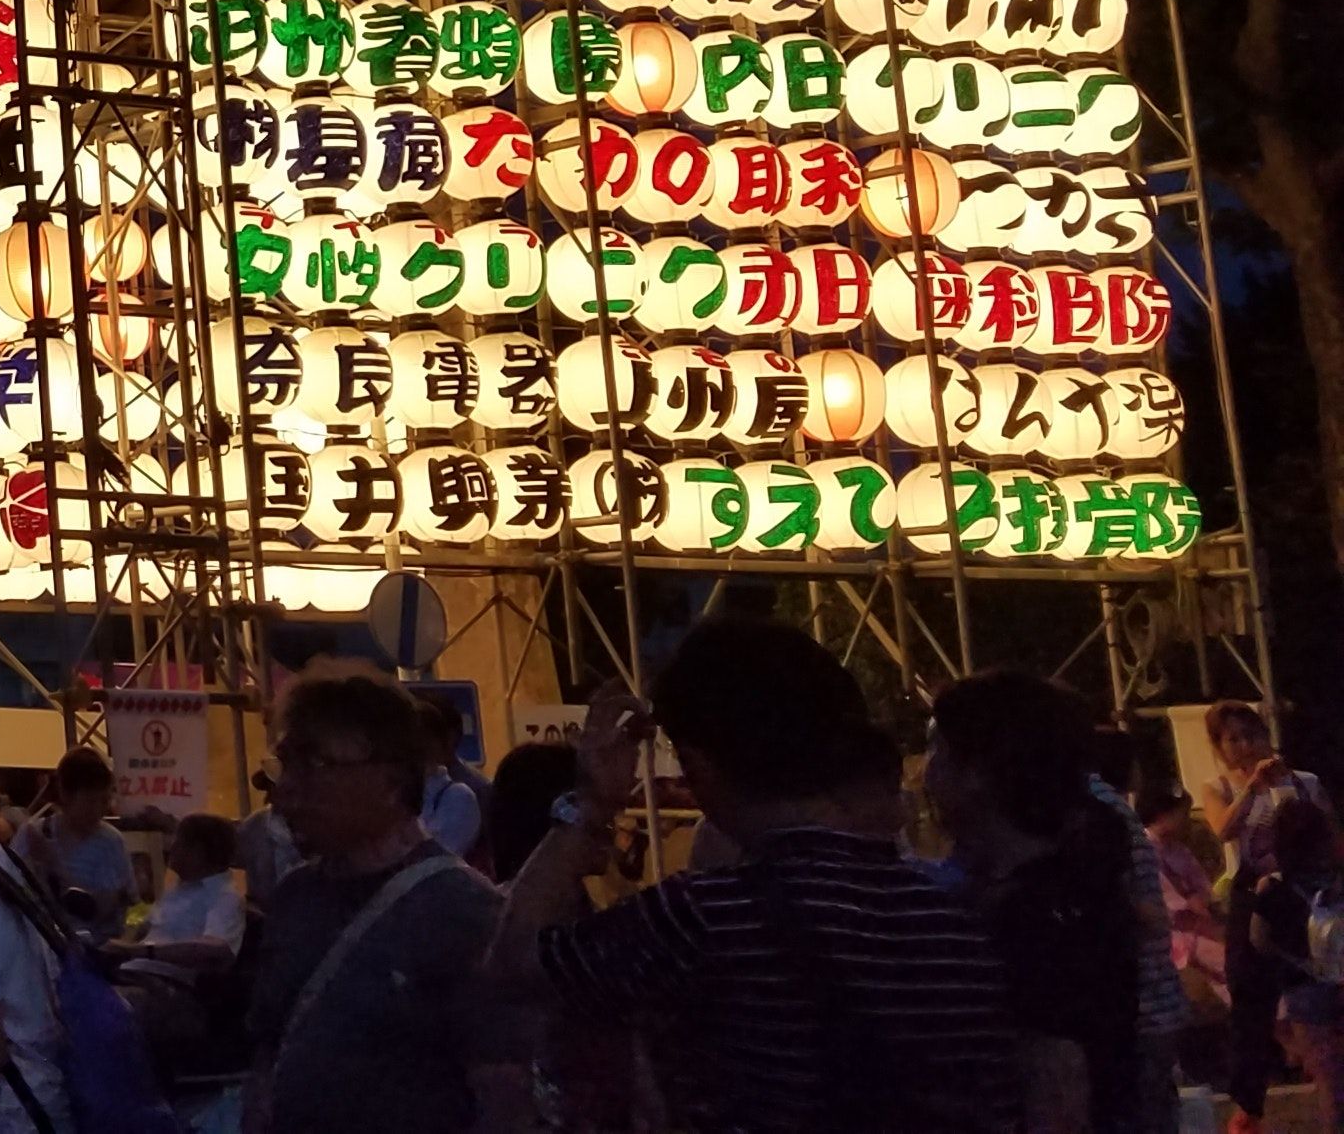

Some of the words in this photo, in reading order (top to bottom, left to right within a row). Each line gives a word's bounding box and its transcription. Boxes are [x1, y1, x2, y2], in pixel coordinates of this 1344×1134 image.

[220, 223, 728, 319] 女性クリニク
[118, 776, 193, 798] 立入禁止
